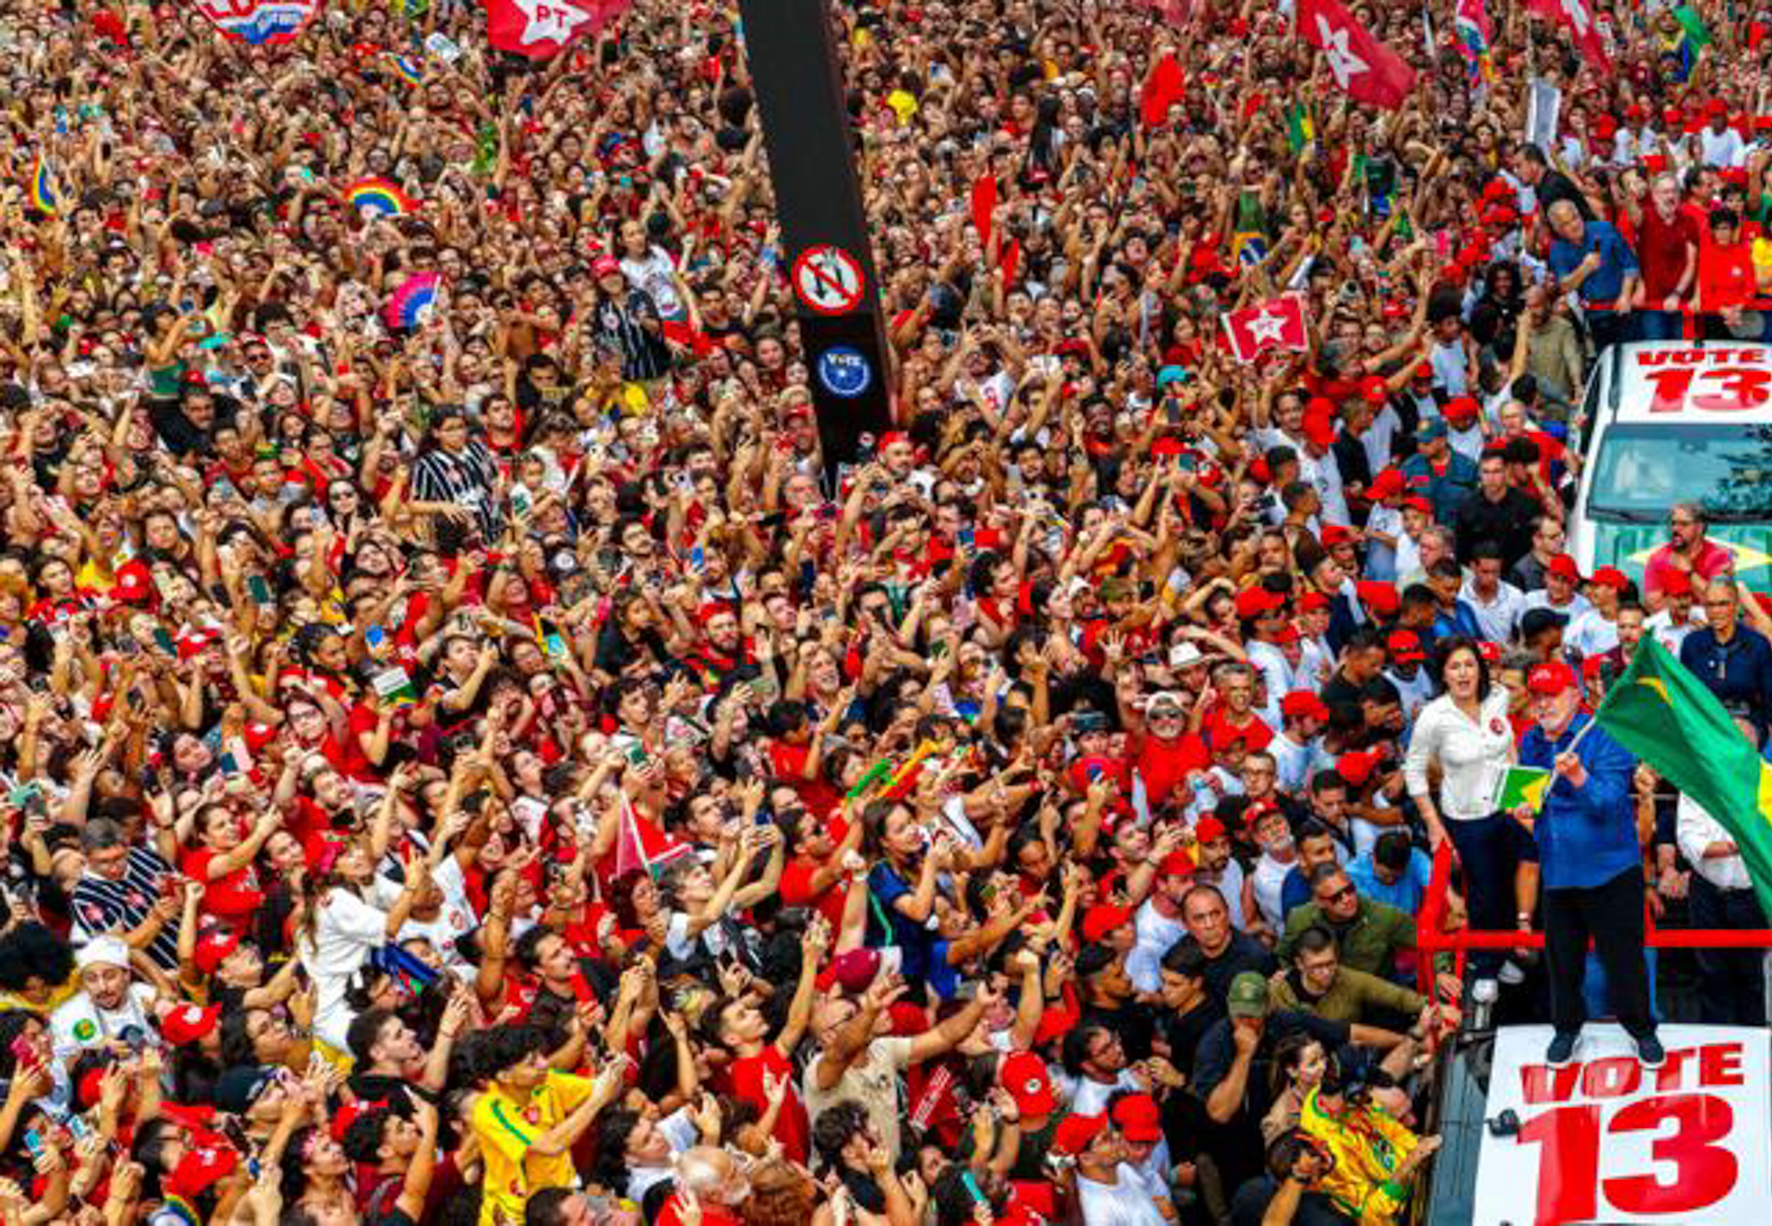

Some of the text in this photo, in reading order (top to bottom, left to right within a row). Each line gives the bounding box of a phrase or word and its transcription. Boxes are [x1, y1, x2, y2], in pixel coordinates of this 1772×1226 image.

[537, 5, 568, 28] PT
[1637, 349, 1767, 366] VOTE
[1644, 367, 1772, 413] 13
[1520, 1043, 1745, 1104] VOTE
[1517, 1093, 1739, 1226] 13
